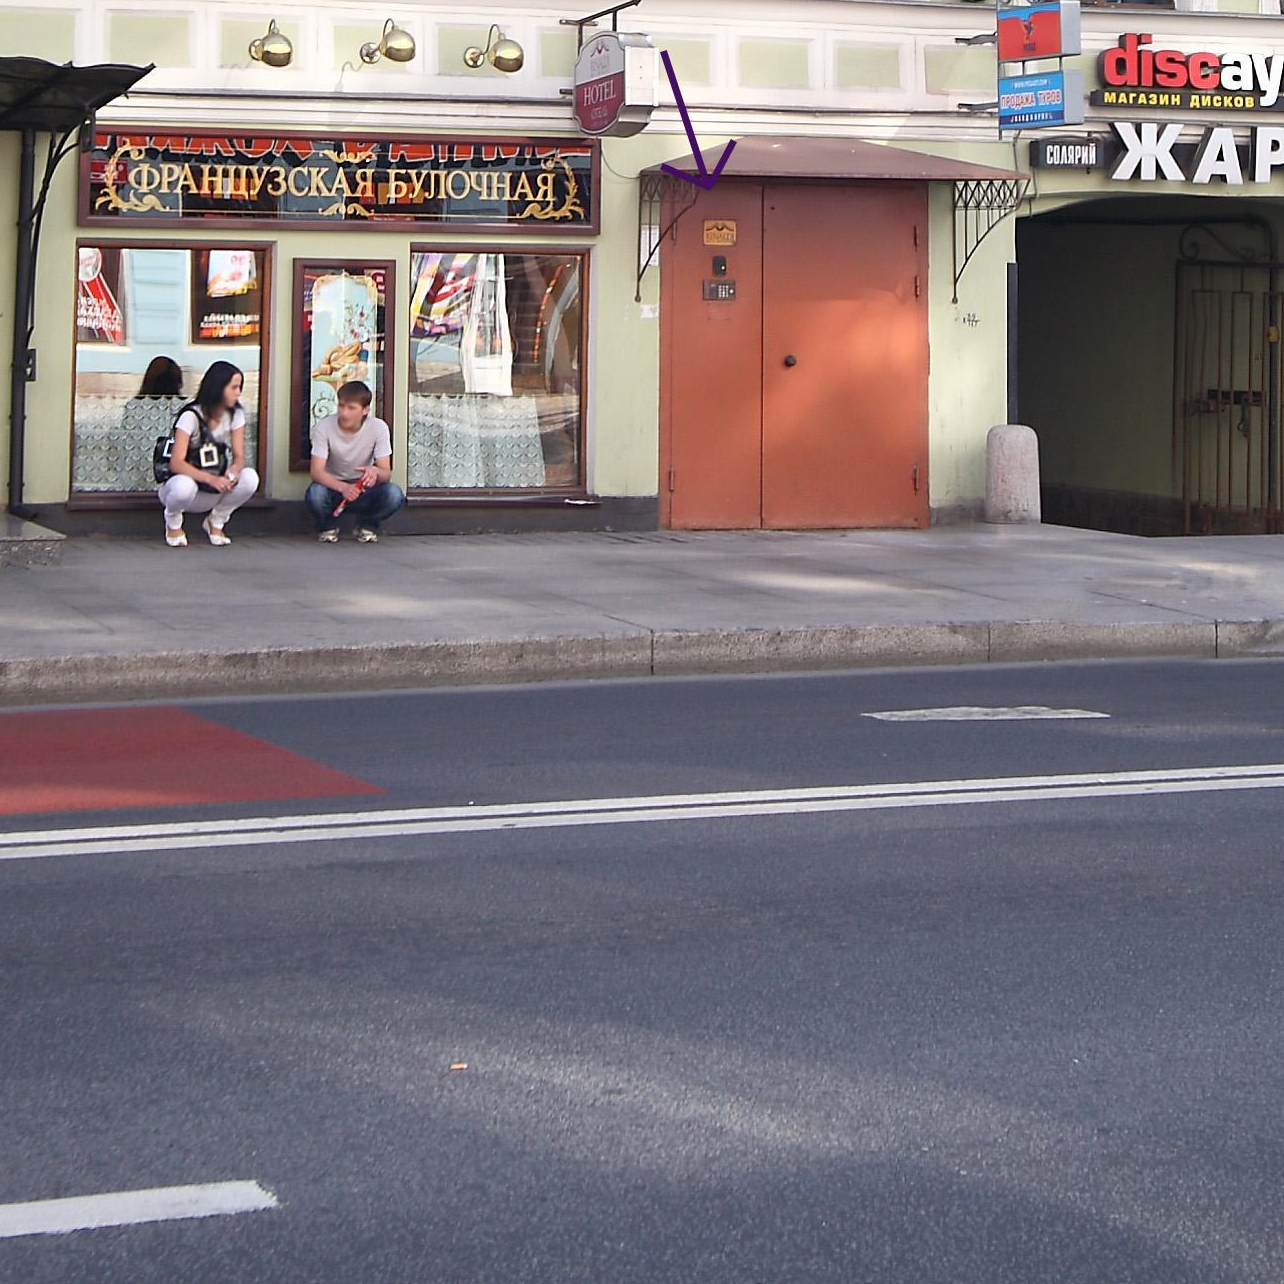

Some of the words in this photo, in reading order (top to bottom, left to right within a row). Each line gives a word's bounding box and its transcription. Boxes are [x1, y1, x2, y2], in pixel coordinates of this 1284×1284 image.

[583, 79, 616, 107] HOTEL
[1000, 92, 1035, 109] ПРОДАЖА
[1037, 89, 1062, 106] ТУРОВ
[1103, 91, 1181, 106] МАГАЗИН
[1189, 93, 1255, 109] ДИСКОВ
[1046, 142, 1096, 165] СОЛЯРИЙ
[127, 161, 374, 202] ФРАНЦУЗСКАЯ
[386, 167, 557, 202] БУЛОЧНАЯ
